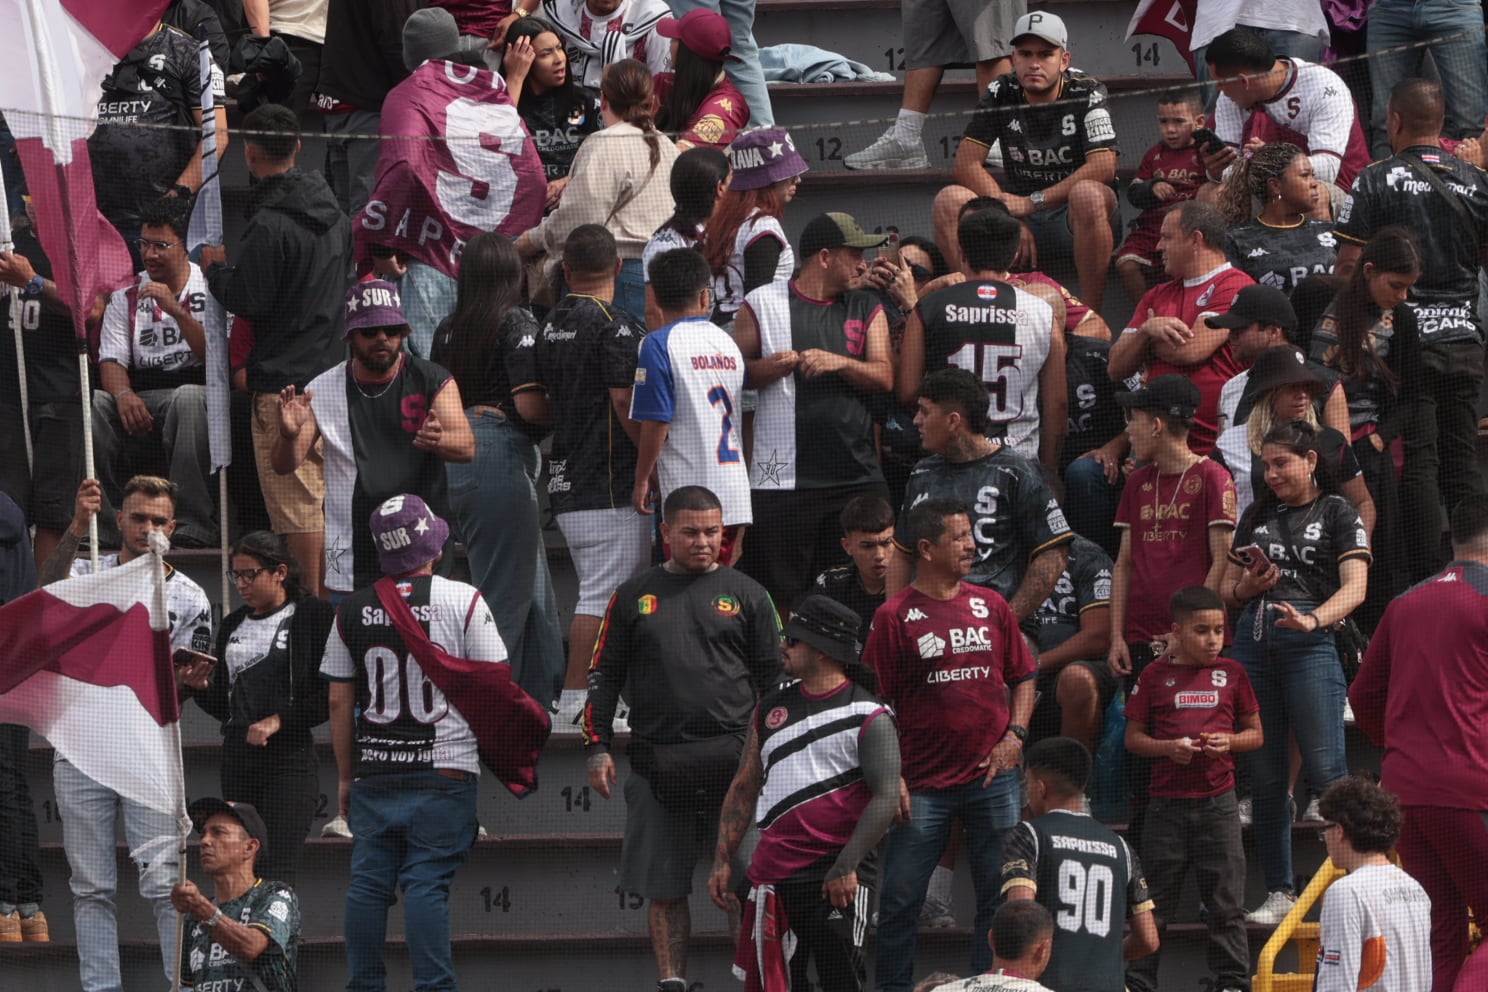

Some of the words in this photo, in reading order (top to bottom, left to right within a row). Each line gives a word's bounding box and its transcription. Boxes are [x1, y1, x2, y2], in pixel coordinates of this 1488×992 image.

[1028, 13, 1044, 31] P
[1131, 42, 1161, 68] 14
[534, 125, 578, 146] BAC
[815, 136, 843, 161] 12
[1027, 146, 1073, 167] BAC
[361, 288, 393, 307] SUR
[944, 303, 1032, 325] Saprissa
[139, 351, 194, 370] LIBERT
[706, 383, 741, 466] 2
[379, 527, 412, 551] SUR
[968, 596, 989, 619] S
[949, 626, 991, 649] BAC
[951, 644, 993, 655] CREDOMATIC
[925, 665, 991, 684] LIBERTY
[1211, 669, 1228, 688] S
[1178, 693, 1217, 706] BIMBO
[390, 749, 416, 764] voy
[560, 786, 591, 812] 14
[1051, 834, 1118, 858] SAPRISSA
[479, 886, 511, 912] 14
[1057, 858, 1113, 938] 90
